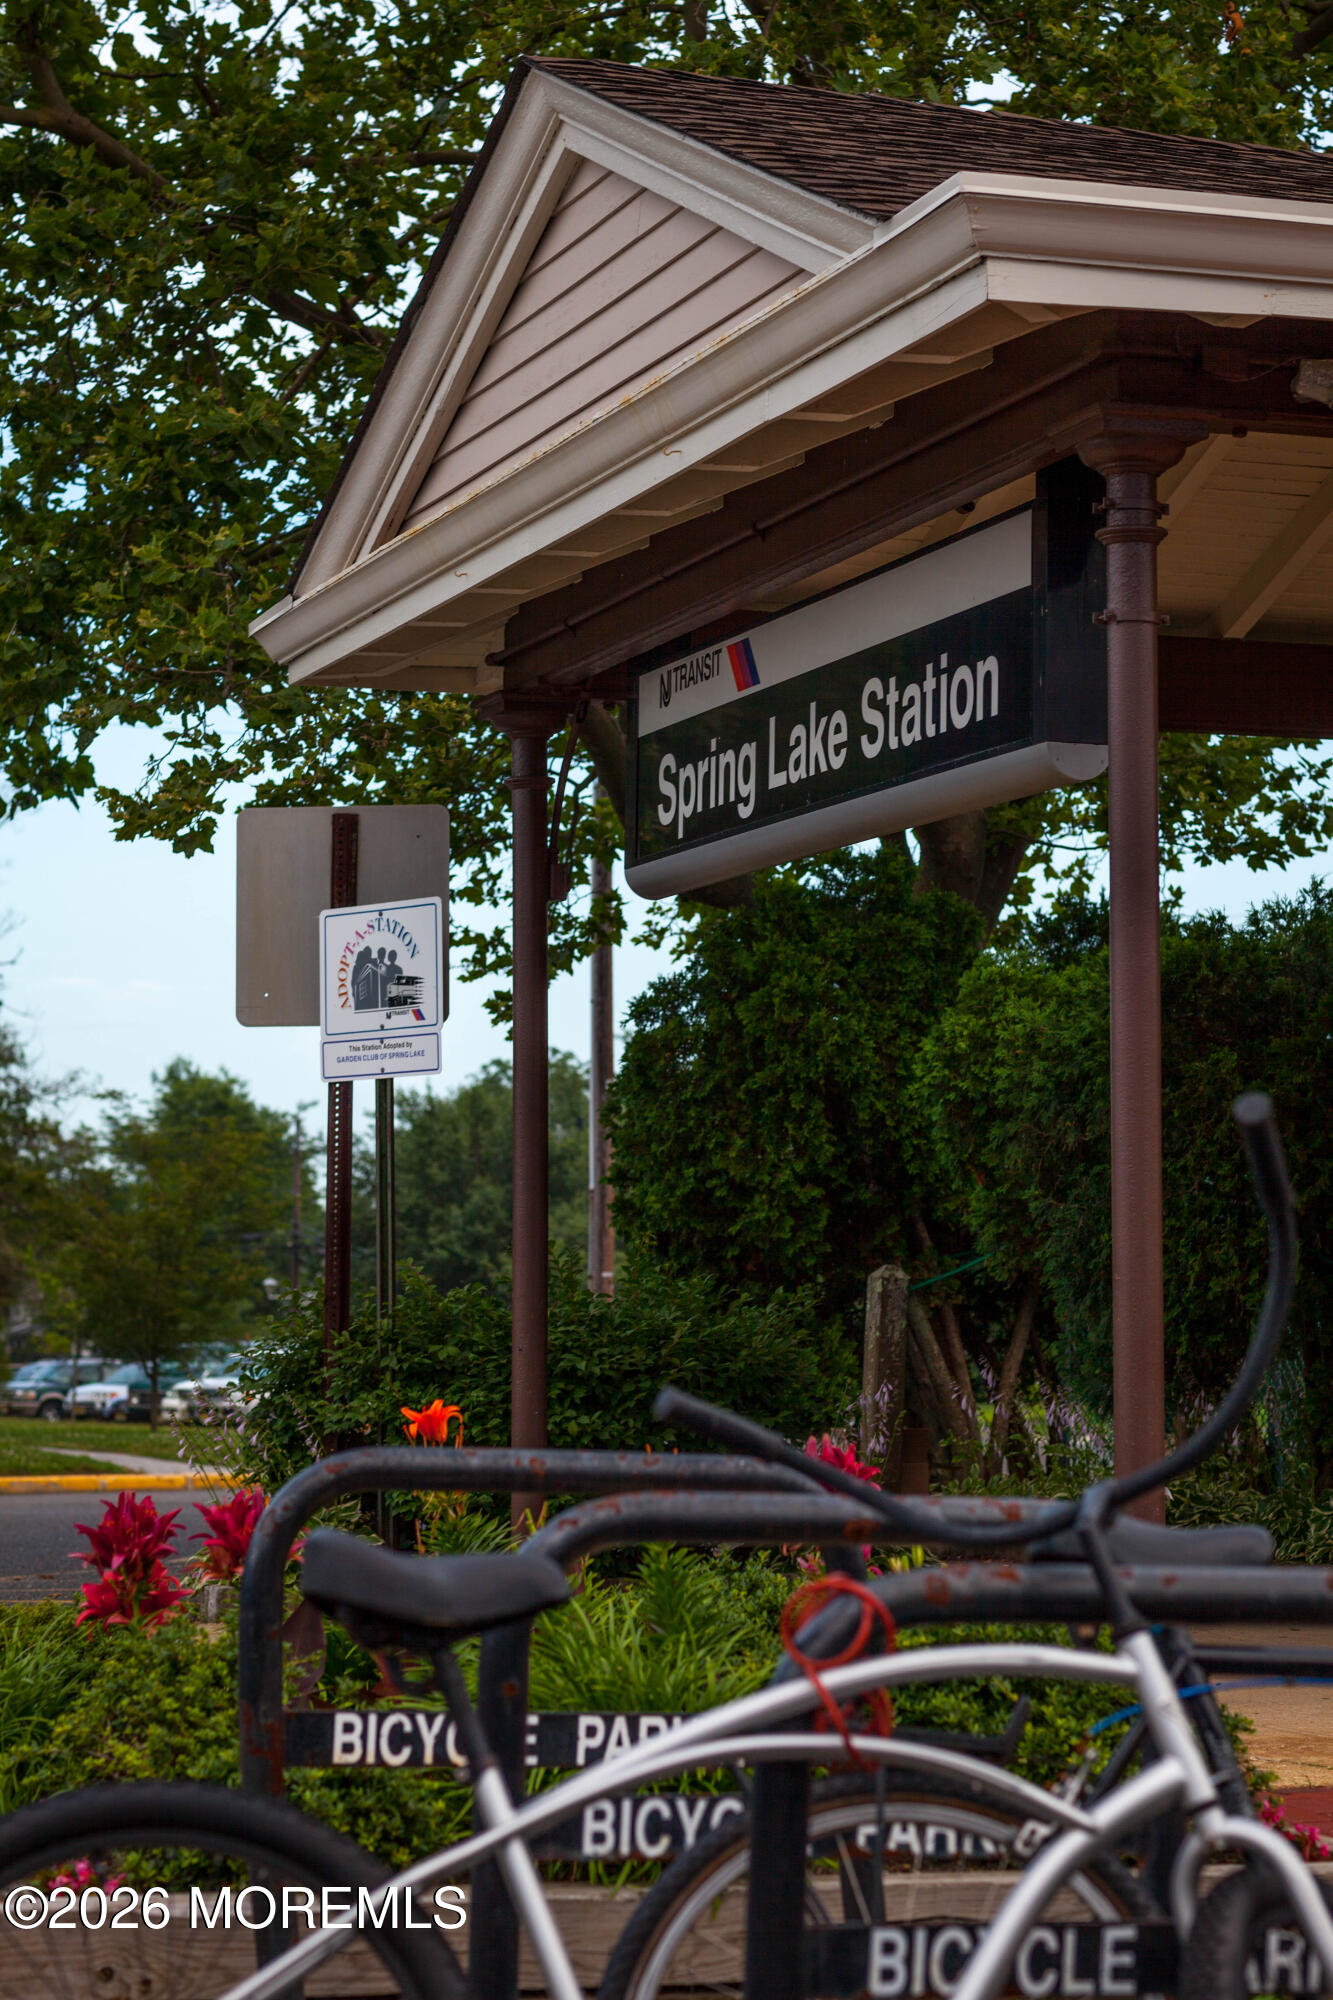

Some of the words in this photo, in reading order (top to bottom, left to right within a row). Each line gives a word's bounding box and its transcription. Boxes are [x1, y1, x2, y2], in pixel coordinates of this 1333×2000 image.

[657, 737, 757, 839] Spring
[768, 701, 848, 790] Lake
[860, 652, 1000, 760] Station
[336, 1055, 362, 1063] GARDEN
[362, 1053, 379, 1061] CLUB
[388, 1051, 409, 1060] SPRING
[409, 1049, 425, 1057] LAKE
[349, 1045, 360, 1053] This
[362, 1043, 382, 1051] Station
[383, 1041, 405, 1050] Adopted
[406, 1041, 413, 1049] by
[867, 1923, 1138, 1997] BICCLE
